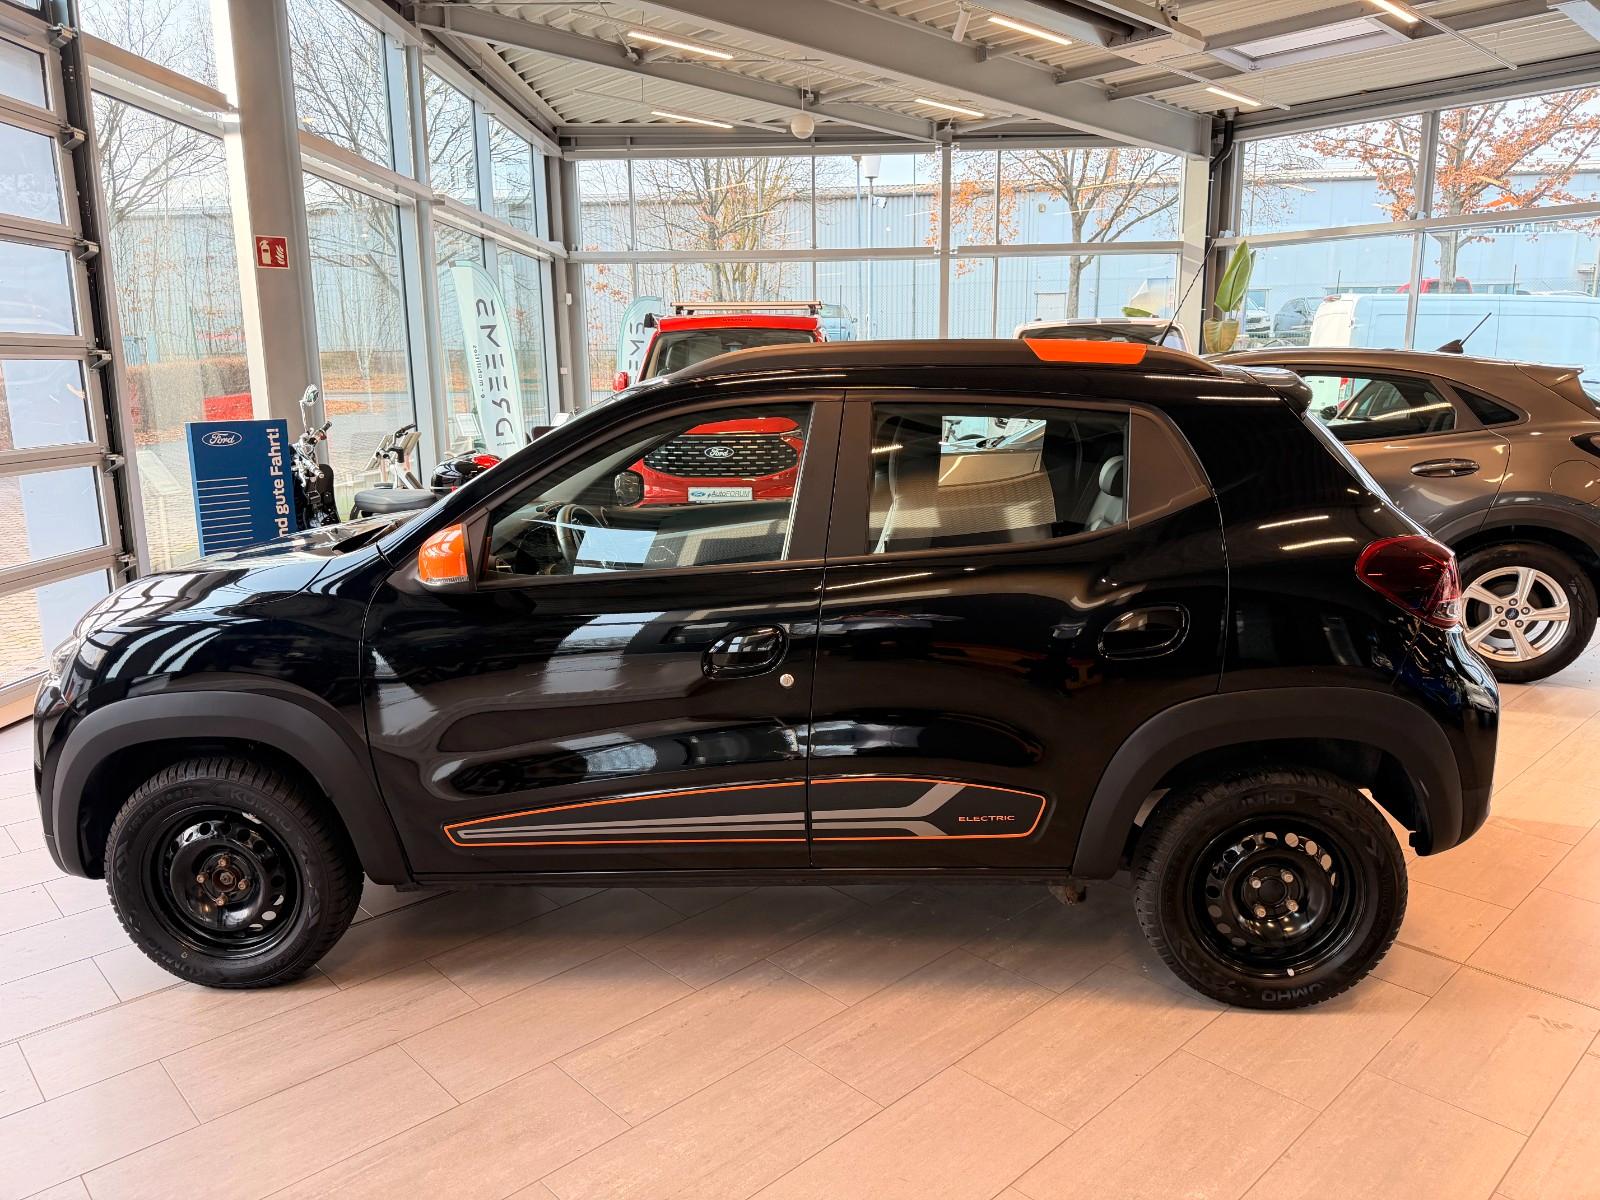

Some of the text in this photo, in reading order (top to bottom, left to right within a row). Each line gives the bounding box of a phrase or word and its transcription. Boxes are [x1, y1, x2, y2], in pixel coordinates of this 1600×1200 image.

[208, 431, 236, 445] Ford
[266, 428, 290, 538] nd gute Fahrt!
